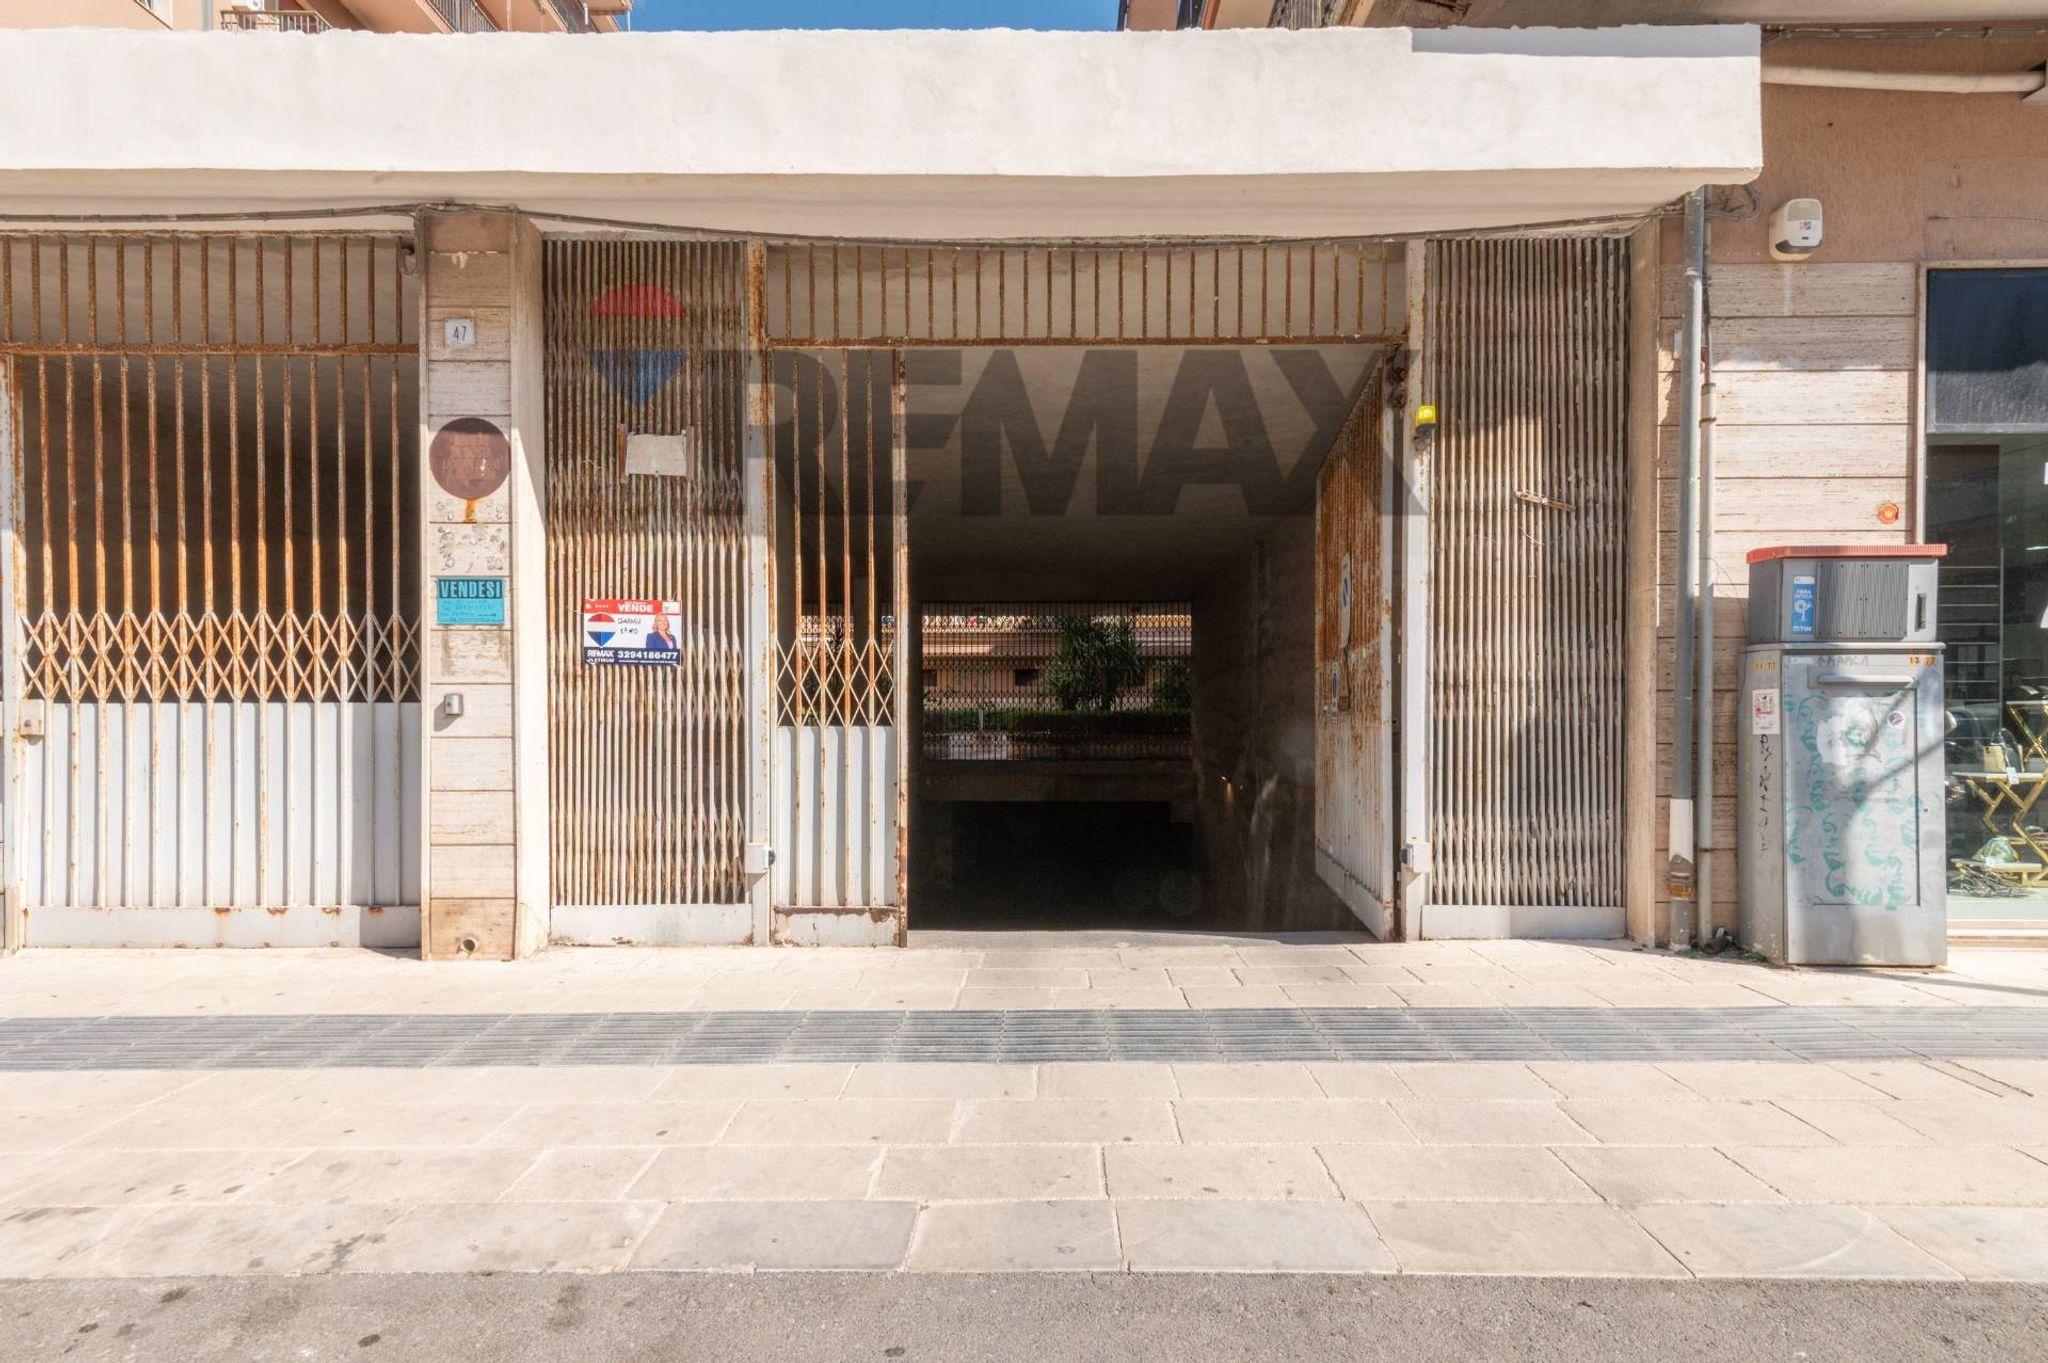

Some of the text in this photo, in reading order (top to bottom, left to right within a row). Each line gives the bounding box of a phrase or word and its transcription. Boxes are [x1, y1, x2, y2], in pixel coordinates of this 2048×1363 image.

[453, 325, 467, 341] 47
[440, 581, 501, 598] VENDESI
[618, 603, 654, 613] VENDE
